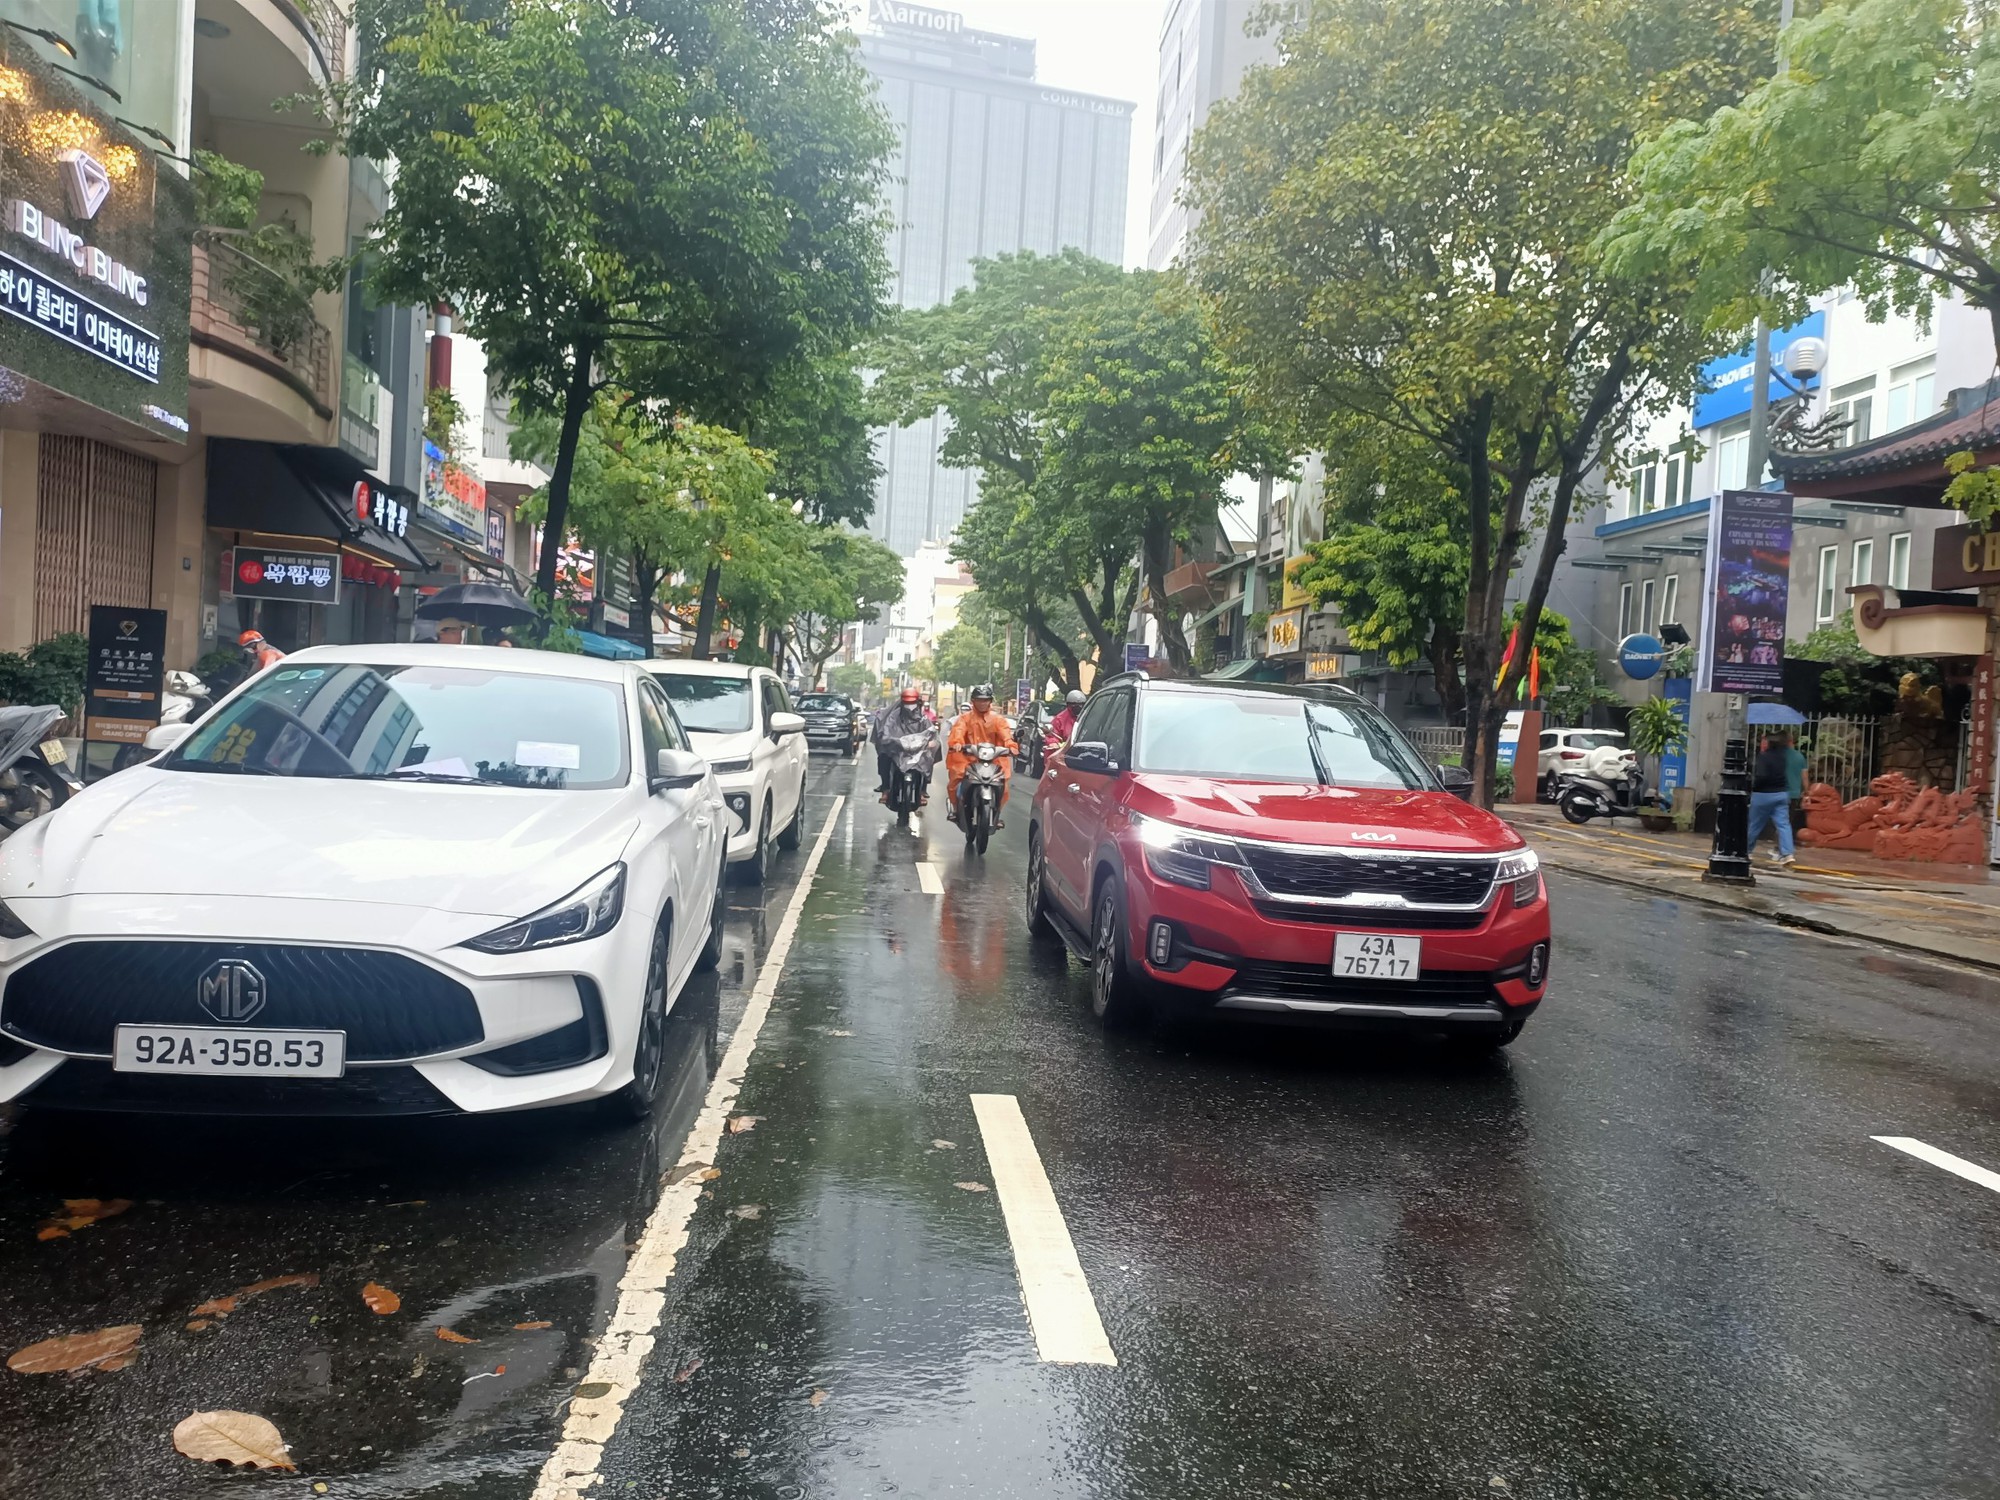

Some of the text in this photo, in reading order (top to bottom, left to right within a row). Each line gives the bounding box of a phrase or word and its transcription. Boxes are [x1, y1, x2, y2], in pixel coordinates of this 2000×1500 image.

[869, 0, 962, 33] Marriott
[22, 200, 148, 307] BLING BLING
[85, 312, 161, 375] 이미테이션샵
[1360, 937, 1396, 956] 43A
[1344, 956, 1410, 976] 767.17
[203, 965, 260, 1018] MG
[136, 1035, 324, 1068] 92A-358.53
